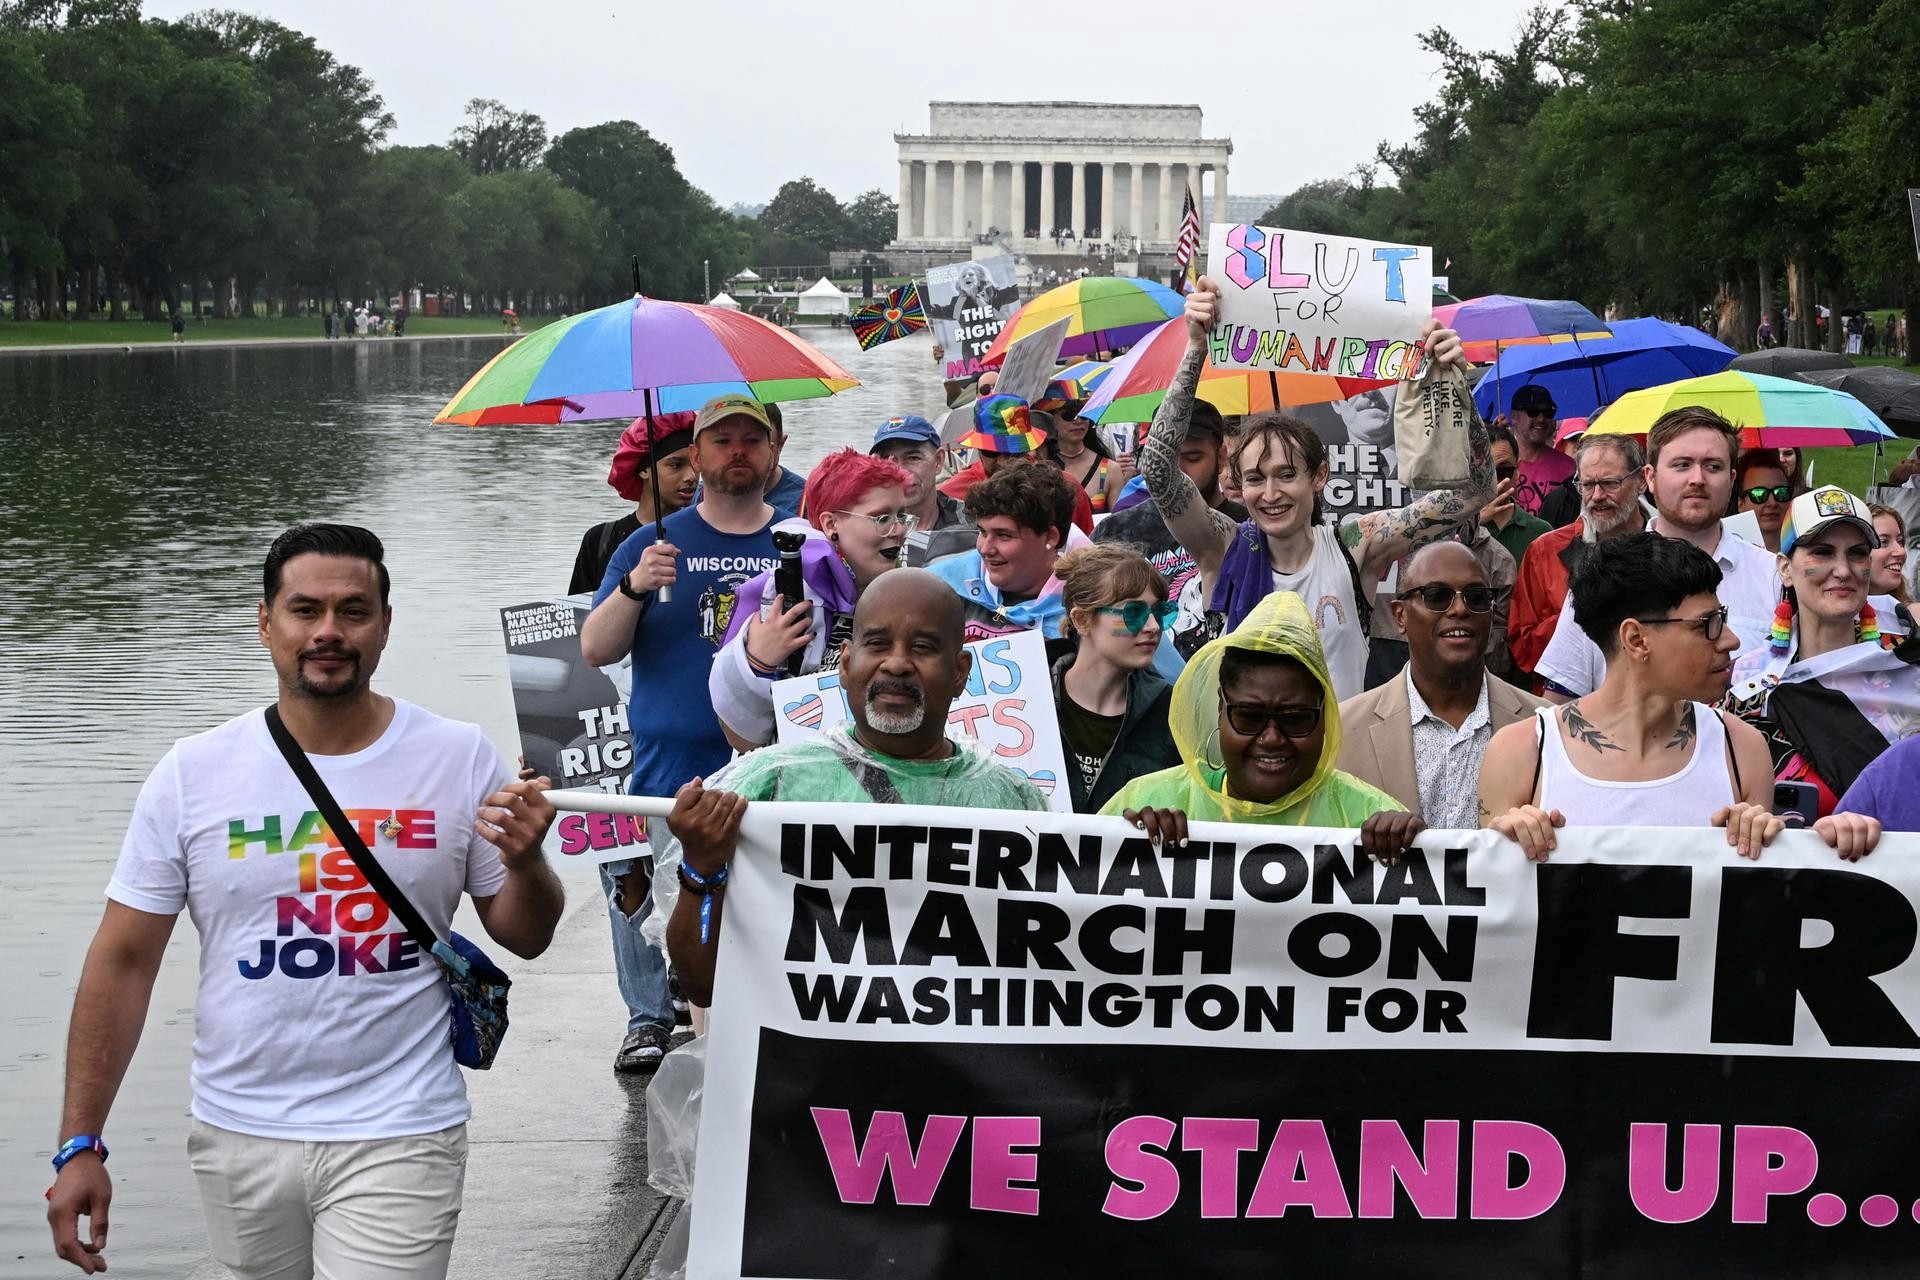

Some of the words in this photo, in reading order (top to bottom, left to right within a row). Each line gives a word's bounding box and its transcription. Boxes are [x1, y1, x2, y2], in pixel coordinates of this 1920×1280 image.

[1225, 224, 1419, 304] SLUT
[962, 305, 994, 322] THE
[1273, 292, 1342, 324] FOR
[1208, 324, 1336, 372] HUMAN
[1338, 337, 1427, 379] RIGHT
[1422, 386, 1434, 429] PRETTY
[1440, 381, 1450, 414] LIKE,
[1324, 444, 1379, 473] HE
[1323, 478, 1407, 507] GHT
[686, 557, 783, 572] WISCONSI
[508, 613, 551, 630] MARCH
[555, 609, 575, 621] ON
[508, 621, 558, 636] WASHINGTON
[561, 618, 575, 627] FOR
[509, 625, 577, 647] FREEDOM
[578, 703, 631, 738] TH
[560, 739, 632, 778] RIG
[228, 808, 437, 860] HATE
[558, 811, 648, 855] SER
[298, 850, 372, 893] IS
[780, 823, 1486, 907] INTERNATIONAL
[276, 892, 389, 937] NO
[784, 883, 1236, 977] MARCH
[1287, 912, 1478, 982] ON
[237, 931, 420, 980] JOKE
[786, 971, 1295, 1033] WASHINGTON
[1326, 986, 1469, 1034] FOR
[810, 1106, 1042, 1216] WE
[1101, 1114, 1566, 1221] STAND
